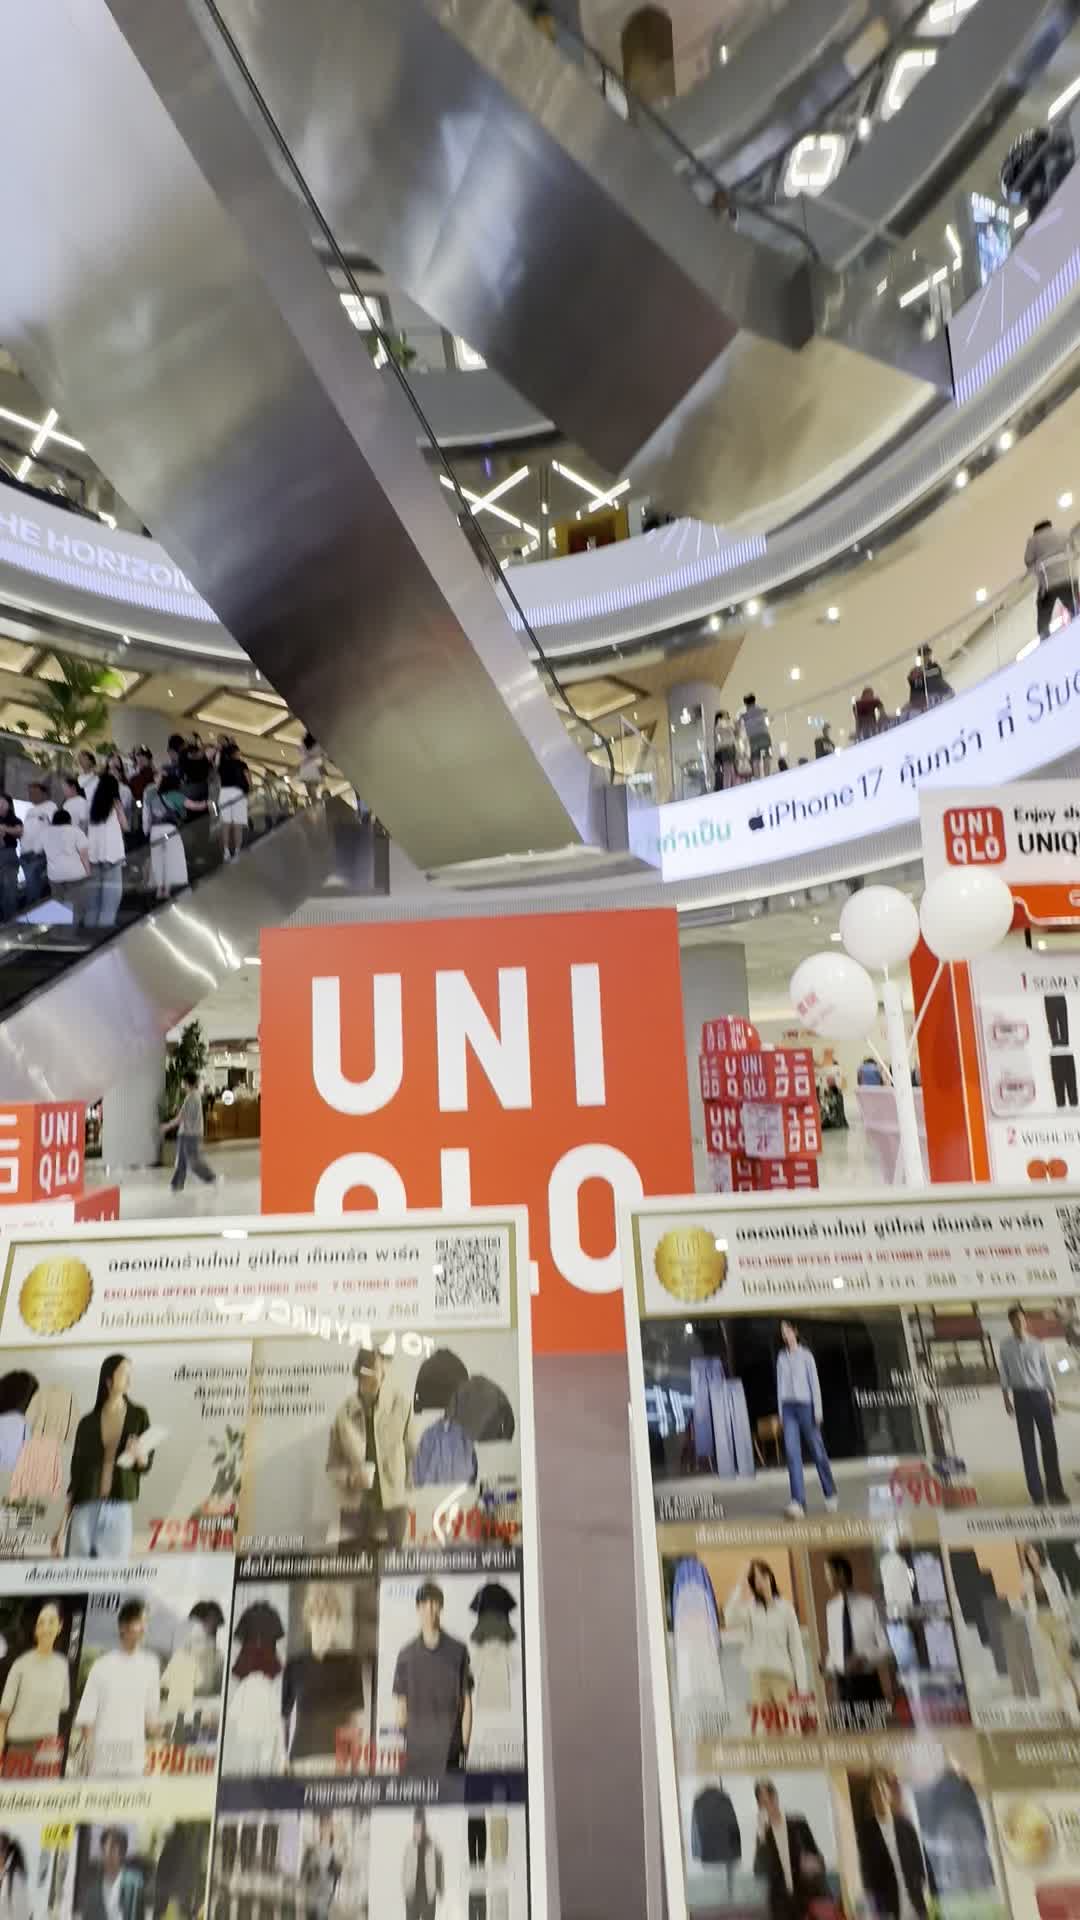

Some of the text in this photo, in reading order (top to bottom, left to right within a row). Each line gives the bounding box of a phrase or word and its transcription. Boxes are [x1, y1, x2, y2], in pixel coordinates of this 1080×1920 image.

[768, 785, 854, 828] iPhone
[857, 765, 884, 799] 17
[950, 811, 994, 836] UNI
[1013, 806, 1056, 823] Enjoy
[952, 836, 1000, 864] QLO
[1018, 831, 1080, 856] UNIQ
[312, 963, 606, 1116] UNI
[41, 1110, 77, 1148] UNI
[40, 1149, 80, 1195] QLO
